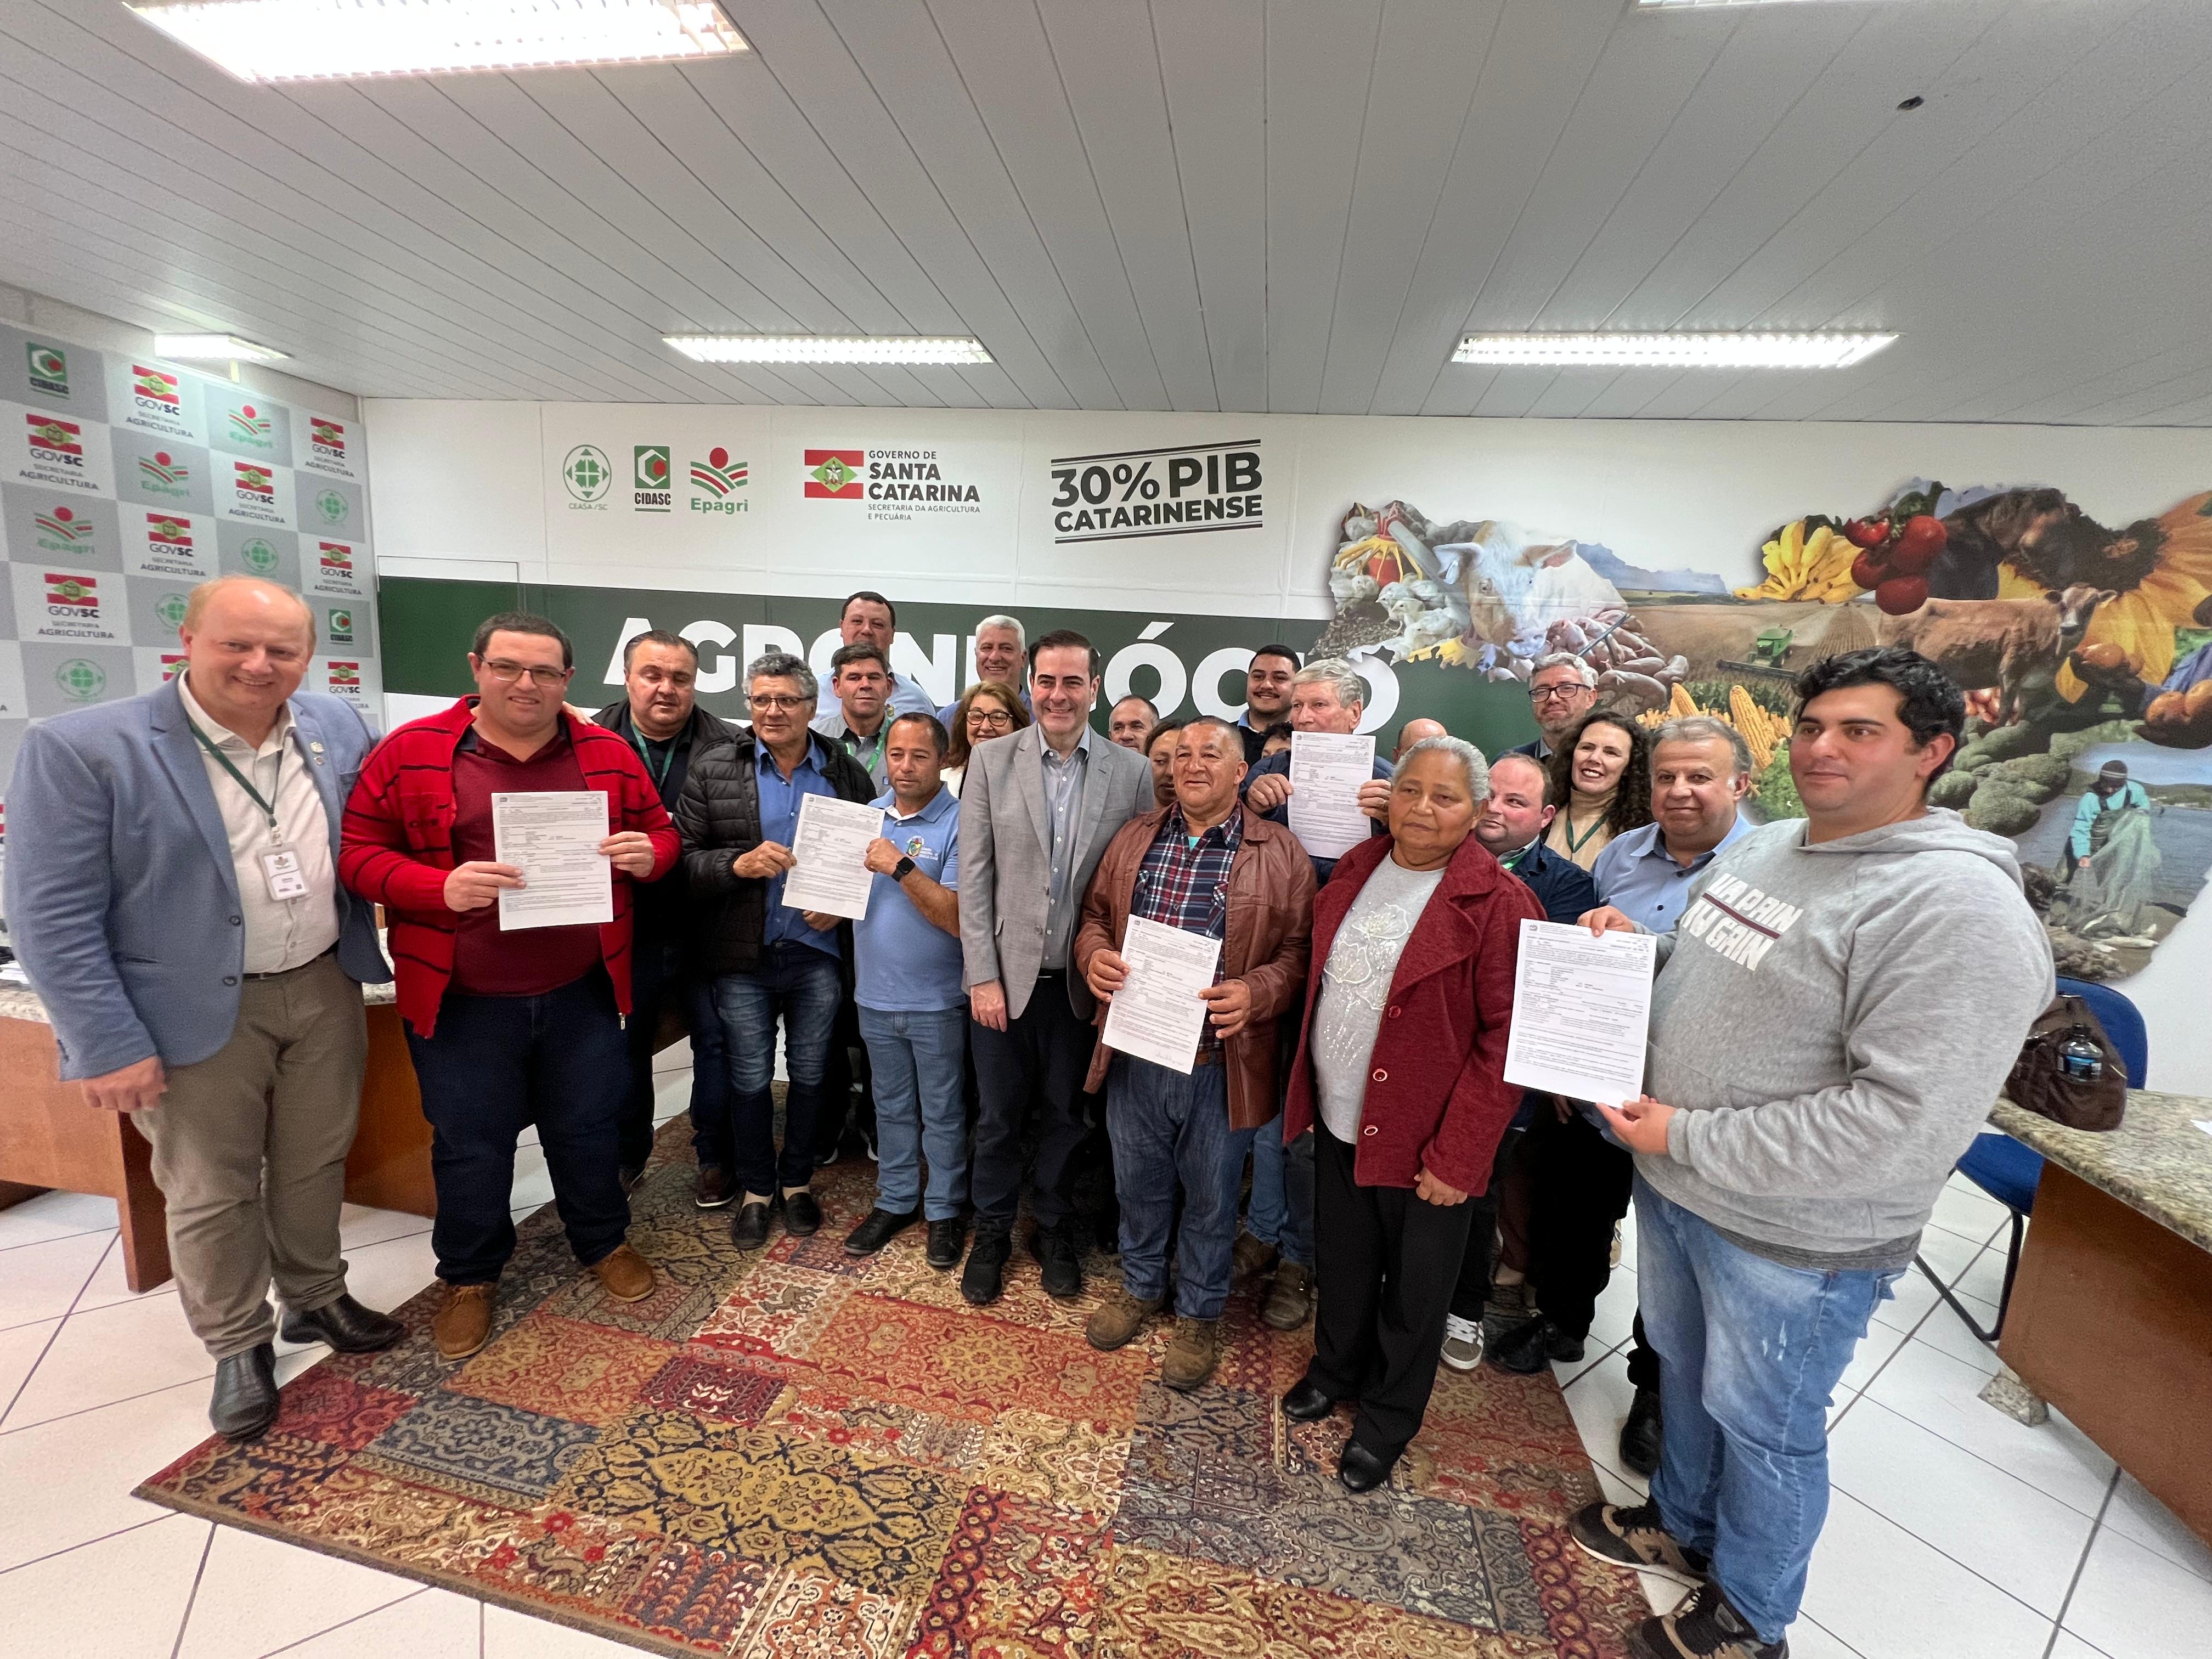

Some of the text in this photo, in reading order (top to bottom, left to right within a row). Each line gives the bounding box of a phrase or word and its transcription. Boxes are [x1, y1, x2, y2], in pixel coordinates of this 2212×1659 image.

[136, 397, 180, 416] GOVSC
[126, 416, 194, 438] AGRICULTURA
[30, 448, 83, 467] GOVSC
[312, 444, 345, 459] GOVSC
[869, 450, 936, 459] GOVERNO DE
[305, 461, 354, 477] AGRICULTURA
[869, 462, 941, 481] SANTA
[20, 470, 99, 490] AGRICULTURA
[1051, 452, 1262, 507] 30% PIB
[236, 490, 274, 505] GOVSC
[635, 492, 671, 506] CIDASC
[868, 483, 980, 503] CATARINA
[691, 498, 748, 515] Epagri
[1054, 495, 1262, 532] CATARINENSE
[229, 509, 285, 523] AGRICULTURA
[874, 512, 912, 521] PECUÁRIA
[150, 544, 194, 557] GOVSC
[140, 563, 206, 576] AGRICULTURA
[320, 567, 352, 579] GOVSC
[314, 585, 362, 595] AGRICULTURA
[48, 606, 101, 618] GOVSC
[38, 628, 115, 639] AGRICULTURA
[329, 686, 360, 694] GOVSC
[1734, 888, 1804, 933] PAIN
[1705, 917, 1775, 971] GAIN
